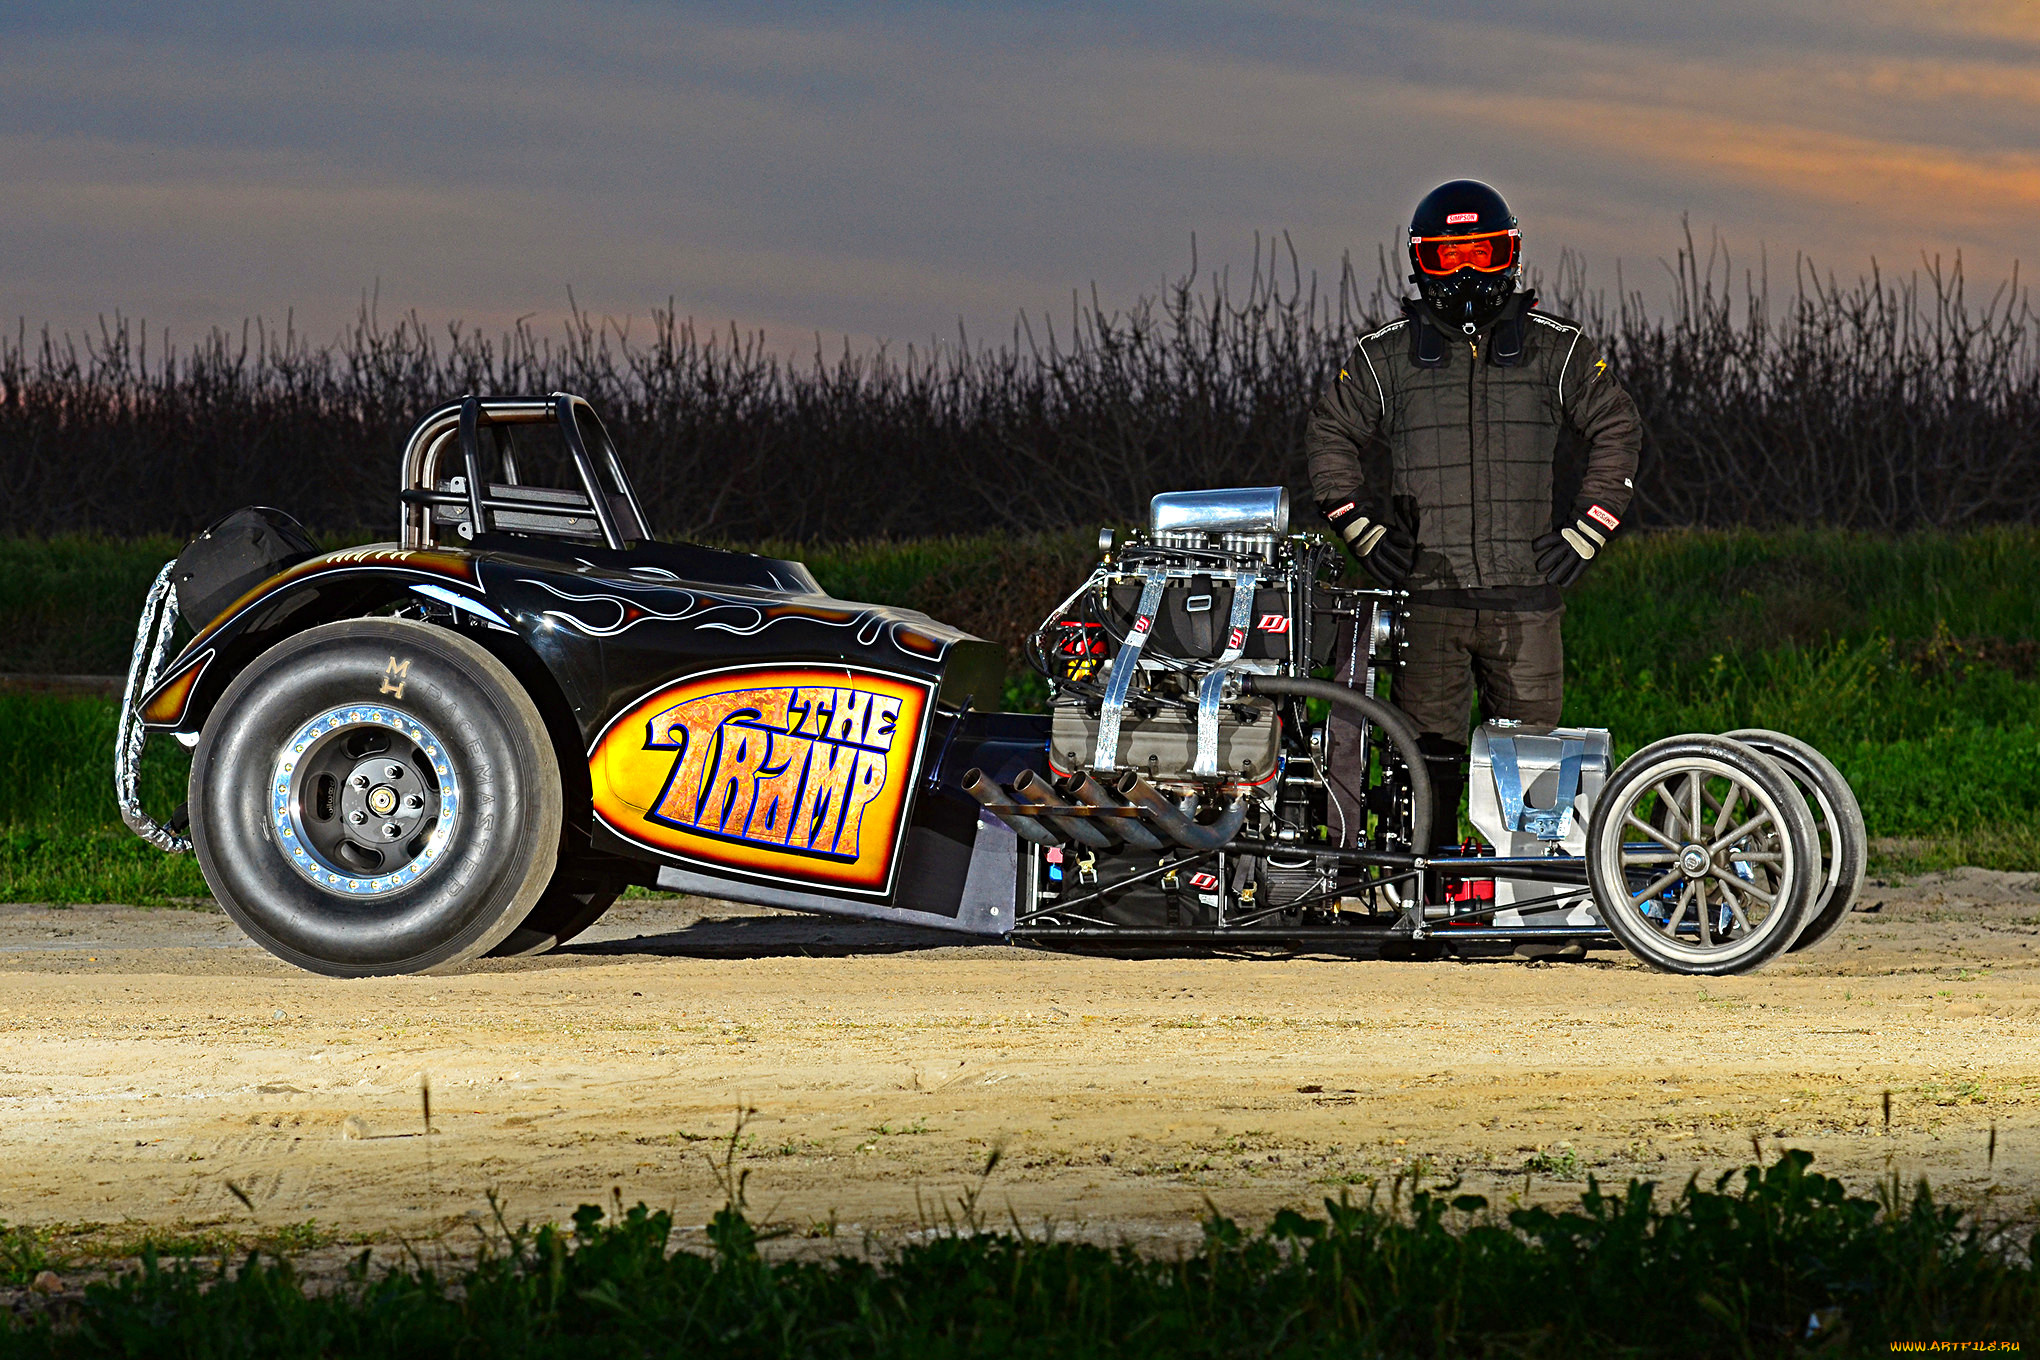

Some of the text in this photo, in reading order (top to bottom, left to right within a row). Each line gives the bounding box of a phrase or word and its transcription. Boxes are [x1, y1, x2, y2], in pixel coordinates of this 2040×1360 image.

[1449, 214, 1475, 222] SIMPSON
[1533, 318, 1570, 333] IMPACT
[787, 686, 903, 751] THE
[641, 687, 888, 865] TRAMP
